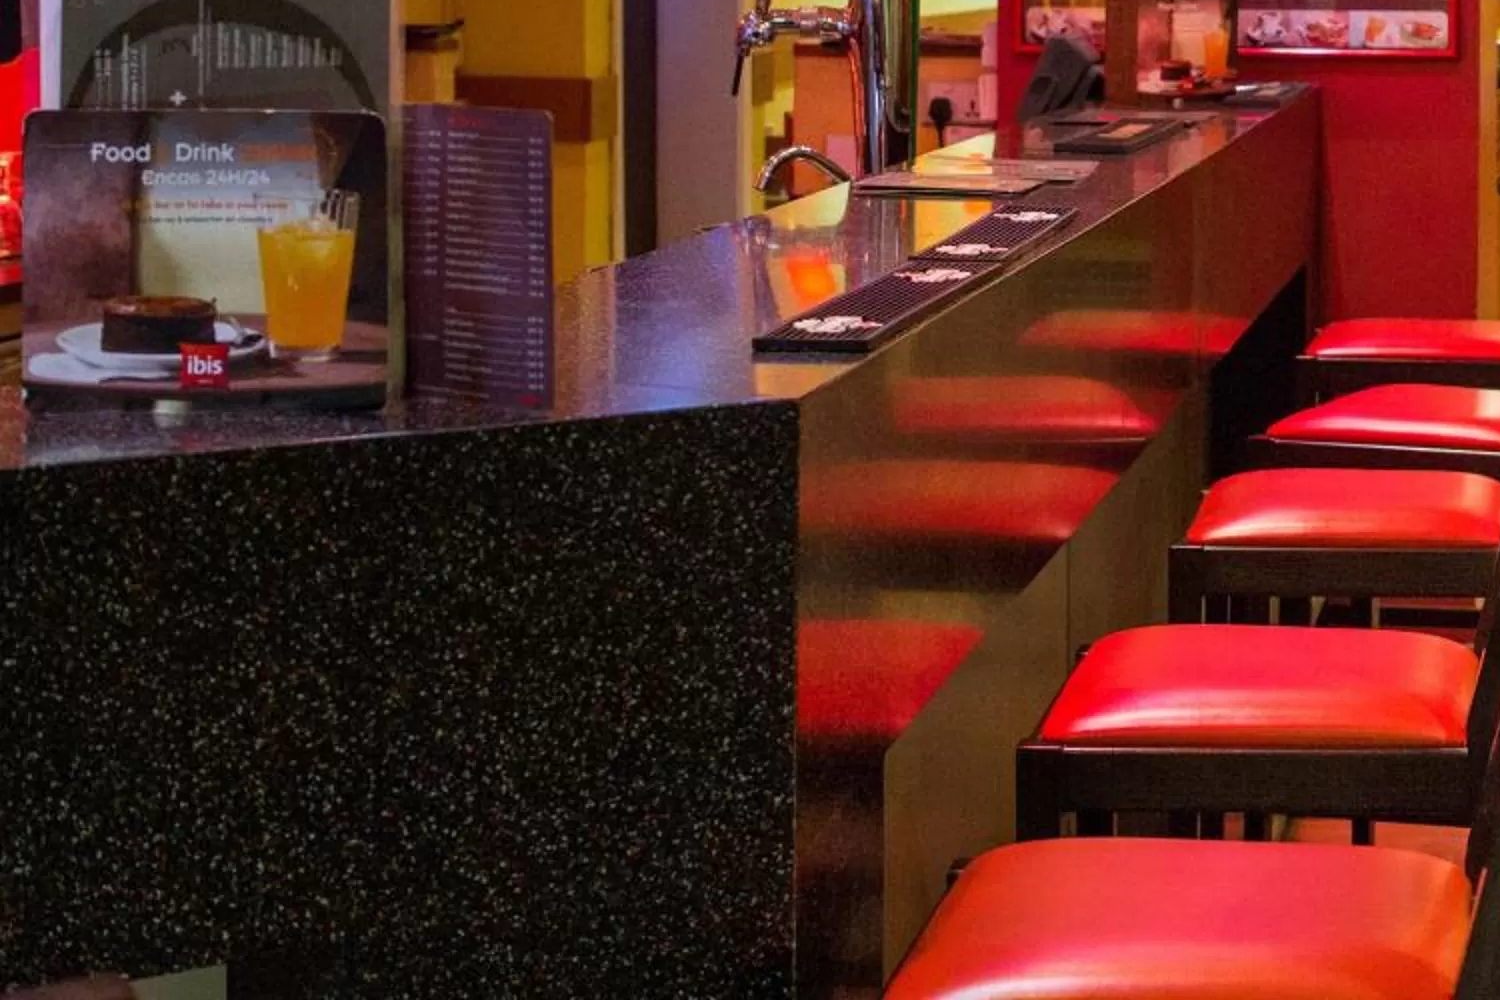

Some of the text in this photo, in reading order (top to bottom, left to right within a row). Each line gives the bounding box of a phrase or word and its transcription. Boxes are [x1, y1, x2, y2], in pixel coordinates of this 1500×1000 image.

[90, 142, 151, 163] Food
[175, 142, 236, 163] Drink
[186, 354, 224, 376] ibis
